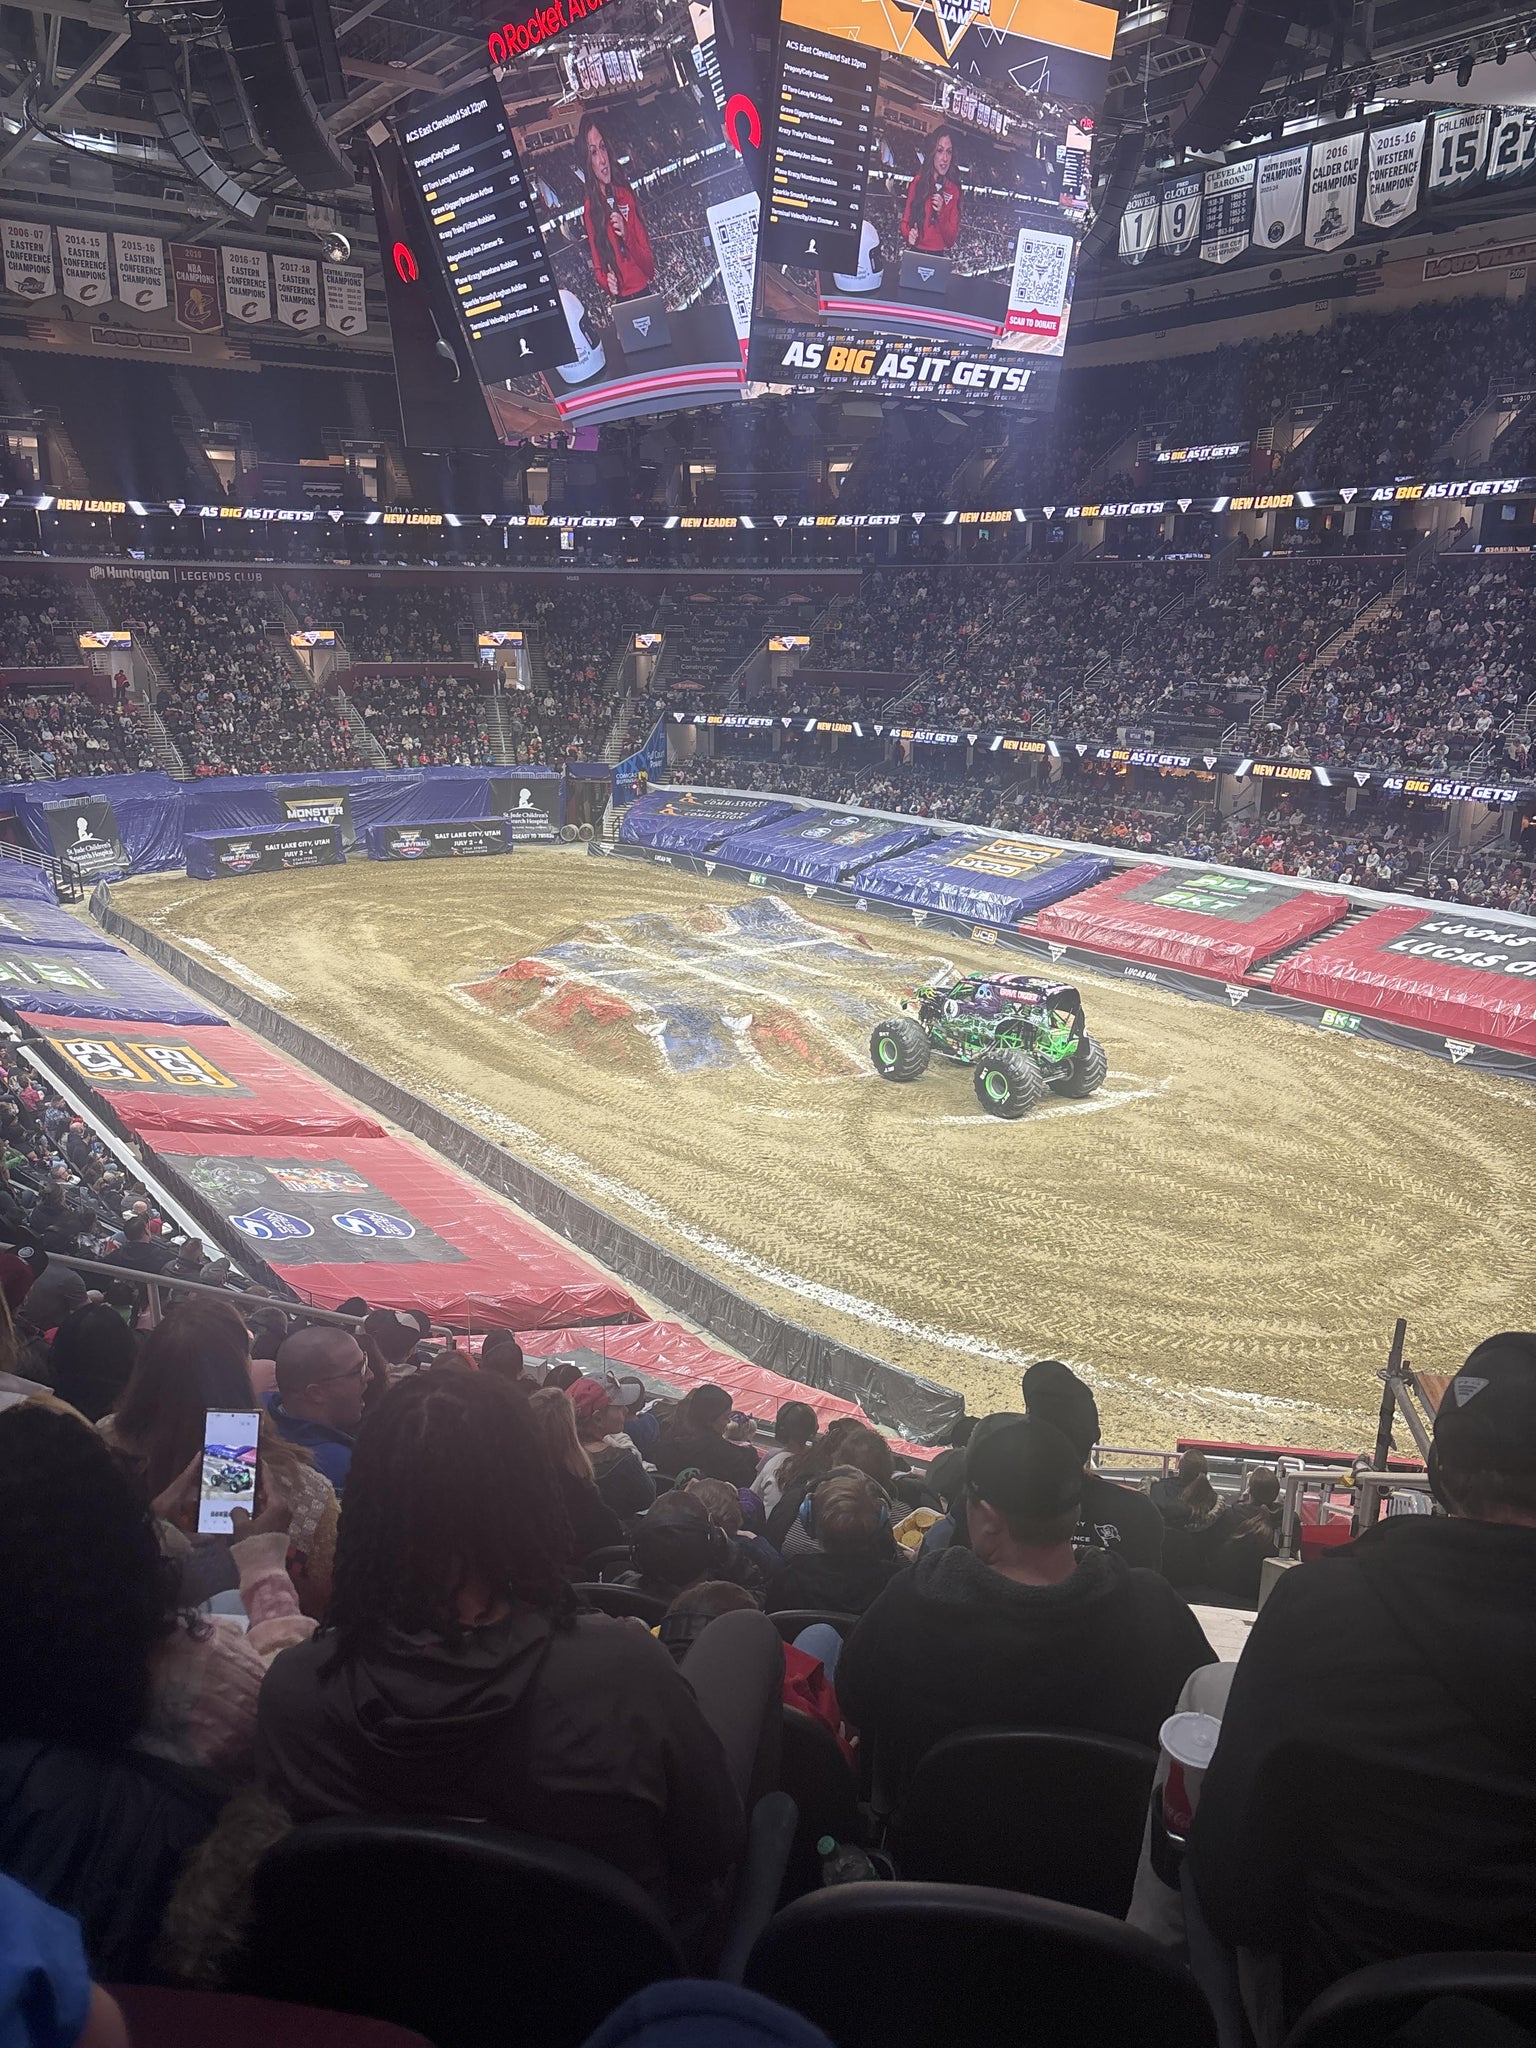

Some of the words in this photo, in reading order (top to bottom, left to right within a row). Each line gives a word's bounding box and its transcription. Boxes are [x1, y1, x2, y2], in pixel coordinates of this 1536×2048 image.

[939, 4, 969, 25] JAM
[502, 0, 568, 57] Rocket
[785, 40, 799, 50] ACS
[799, 44, 812, 54] East
[812, 47, 841, 62] Cleveland
[840, 55, 851, 65] Sat
[851, 57, 867, 69] 12pm
[406, 130, 420, 143] ACS
[418, 124, 433, 138] East
[431, 110, 461, 131] Cleveland
[460, 106, 472, 119] Sat
[470, 99, 488, 113] 12pm
[1438, 113, 1486, 133] CALLANDER
[1377, 131, 1416, 150] 2015-16
[1326, 145, 1348, 160] 2016
[1376, 148, 1414, 166] WESTERN
[1439, 130, 1479, 178] 15
[1279, 157, 1302, 168] DIVISION
[1312, 162, 1343, 180] CALDER
[1343, 157, 1359, 173] CUP
[1206, 163, 1254, 182] CLEVELAND
[1260, 165, 1303, 184] CHAMPIONS
[1369, 161, 1419, 181] CONFERENCE
[1213, 174, 1245, 189] BARONS
[1312, 173, 1358, 195] CHAMPIONS
[1369, 176, 1415, 195] CHAMPIONS
[1164, 184, 1200, 200] GLOVER
[1126, 196, 1156, 210] BOWER
[1173, 203, 1187, 237] 9
[8, 226, 44, 239] 2006-07
[1134, 213, 1144, 248] 1
[10, 239, 44, 253] EASTERN
[65, 235, 100, 247] 2014-15
[121, 240, 156, 253] 2015-16
[6, 250, 52, 263] CONFERENCE
[68, 247, 100, 259] EASTERN
[124, 253, 155, 265] EASTERN
[229, 254, 260, 265] 2016-17
[9, 261, 51, 274] CHAMPIONS
[63, 257, 107, 270] CONFERENCE
[119, 263, 162, 276] CONFERENCE
[187, 263, 202, 274] NBA
[280, 262, 311, 273] 2017-18
[66, 268, 106, 280] CHAMPIONS
[176, 272, 215, 285] CHAMPIONS
[231, 267, 260, 278] EASTERN
[282, 274, 310, 285] EASTERN
[122, 274, 161, 286] CHAMPIONS
[226, 276, 267, 289] CONFERENCE
[326, 276, 362, 287] CHAMPIONS
[229, 286, 266, 299] CHAMPIONS
[277, 284, 317, 296] CONFERENCE
[280, 293, 316, 306] CHAMPIONS
[1009, 315, 1024, 326] SCAN
[1025, 318, 1036, 328] TO
[1035, 319, 1057, 331] DONATE
[781, 340, 825, 369] AS
[825, 347, 877, 375] BIG
[876, 354, 916, 380] AS
[917, 357, 951, 383] IT
[951, 363, 1032, 393] GETS!
[1371, 488, 1395, 501] AS
[1395, 486, 1424, 499] BIG
[1423, 484, 1449, 499] AS
[1449, 483, 1468, 497] IT
[1468, 480, 1521, 496] GETS!
[57, 499, 83, 511] NEW
[84, 500, 126, 513] LEADER
[1065, 507, 1080, 517] AS
[1081, 506, 1100, 516] BIG
[1100, 505, 1117, 516] AS
[1116, 504, 1130, 515] IT
[1130, 502, 1164, 514] GETS!
[1230, 497, 1254, 510] NEW
[1254, 495, 1294, 509] LEADER
[199, 506, 219, 517] AS
[219, 507, 243, 518] BIG
[242, 508, 261, 519] AS
[261, 509, 276, 519] IT
[276, 510, 314, 520] GETS!
[383, 513, 405, 524] NEW
[406, 514, 442, 525] LEADER
[959, 511, 979, 523] NEW
[980, 511, 1012, 522] LEADER
[509, 516, 526, 526] AS
[527, 516, 549, 526] BIG
[549, 517, 567, 526] AS
[567, 517, 582, 526] IT
[582, 517, 617, 527] GETS!
[680, 518, 702, 528] NEW
[703, 518, 737, 529] LEADER
[798, 516, 815, 526] AS
[816, 516, 836, 526] BIG
[837, 516, 853, 526] AS
[852, 515, 867, 526] IT
[867, 515, 901, 525] GETS!
[106, 566, 170, 583] Huntington
[181, 571, 231, 581] LEGENDS
[234, 572, 263, 582] CLUB
[1002, 740, 1019, 750] NEW
[1019, 741, 1046, 752] LEADER
[1096, 750, 1111, 759] AS
[1112, 750, 1130, 760] BIG
[1130, 751, 1146, 762] AS
[1144, 753, 1158, 763] IT
[1159, 754, 1191, 766] GETS!
[1253, 764, 1275, 777] NEW
[1275, 766, 1312, 780] LEADER
[1383, 778, 1403, 790] AS
[1404, 778, 1431, 792] BIG
[1431, 781, 1454, 794] AS
[1452, 783, 1472, 797] IT
[1472, 787, 1517, 801] GETS!
[286, 806, 344, 819] MONSTER
[265, 843, 280, 851] SALT
[281, 841, 297, 849] LAKE
[298, 840, 313, 849] CITY,
[314, 838, 330, 846] UTAH
[454, 839, 468, 847] JULY
[284, 850, 298, 858] JULY
[974, 929, 996, 942] JCB
[1389, 938, 1509, 967] LUCAS
[1124, 966, 1147, 979] LUCAS
[1146, 972, 1158, 981] OIL
[1322, 1010, 1361, 1030] BKT
